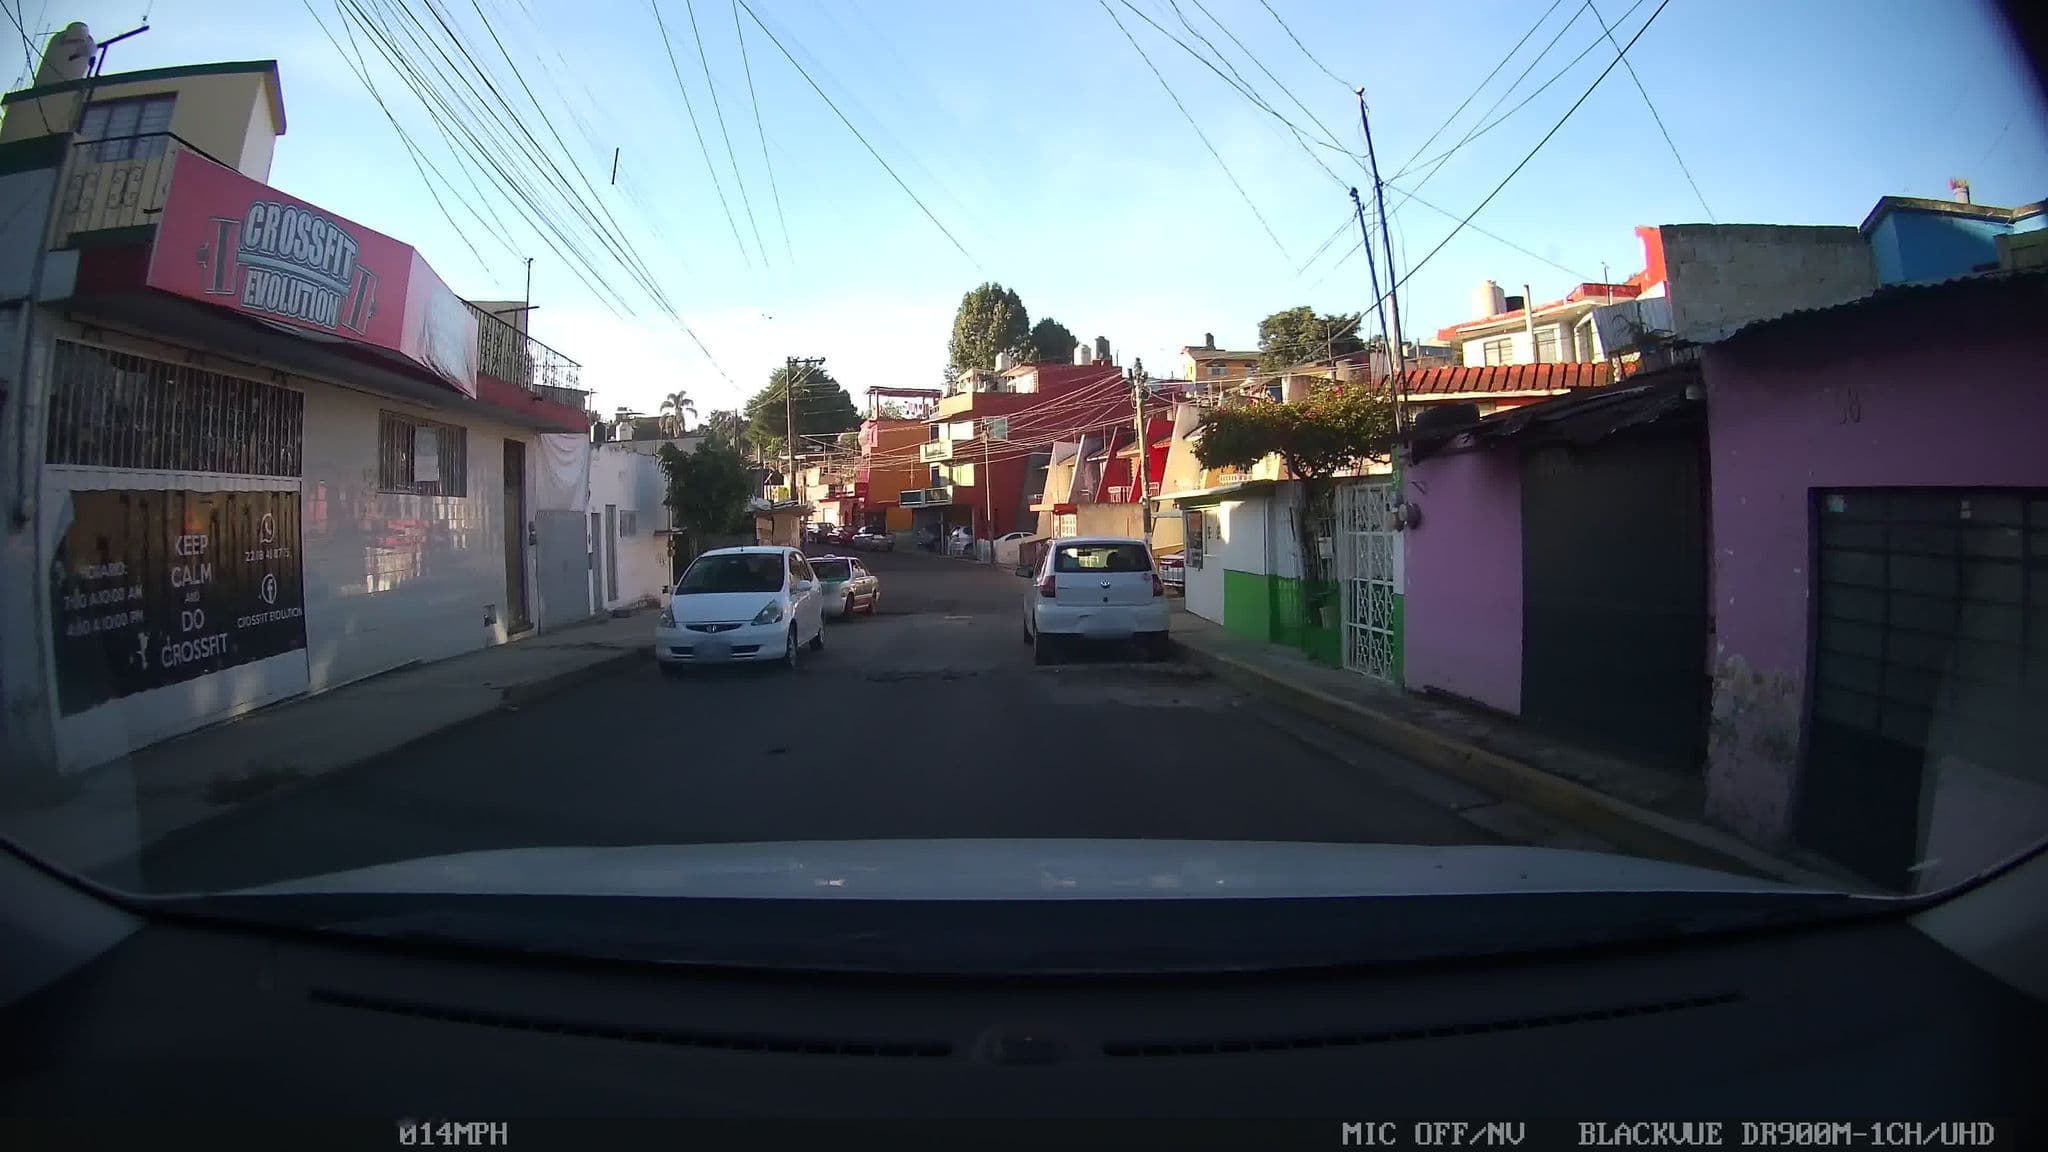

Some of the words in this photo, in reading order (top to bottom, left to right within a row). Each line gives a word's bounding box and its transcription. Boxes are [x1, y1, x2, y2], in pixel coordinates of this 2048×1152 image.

[243, 203, 357, 285] CROSSFIT
[242, 268, 343, 328] EVOLUTION
[175, 534, 209, 556] KEEP
[171, 562, 213, 588] CALM
[127, 584, 143, 600] AM
[185, 591, 201, 602] AND
[181, 608, 205, 632] DO
[161, 633, 229, 668] CROSSFIT
